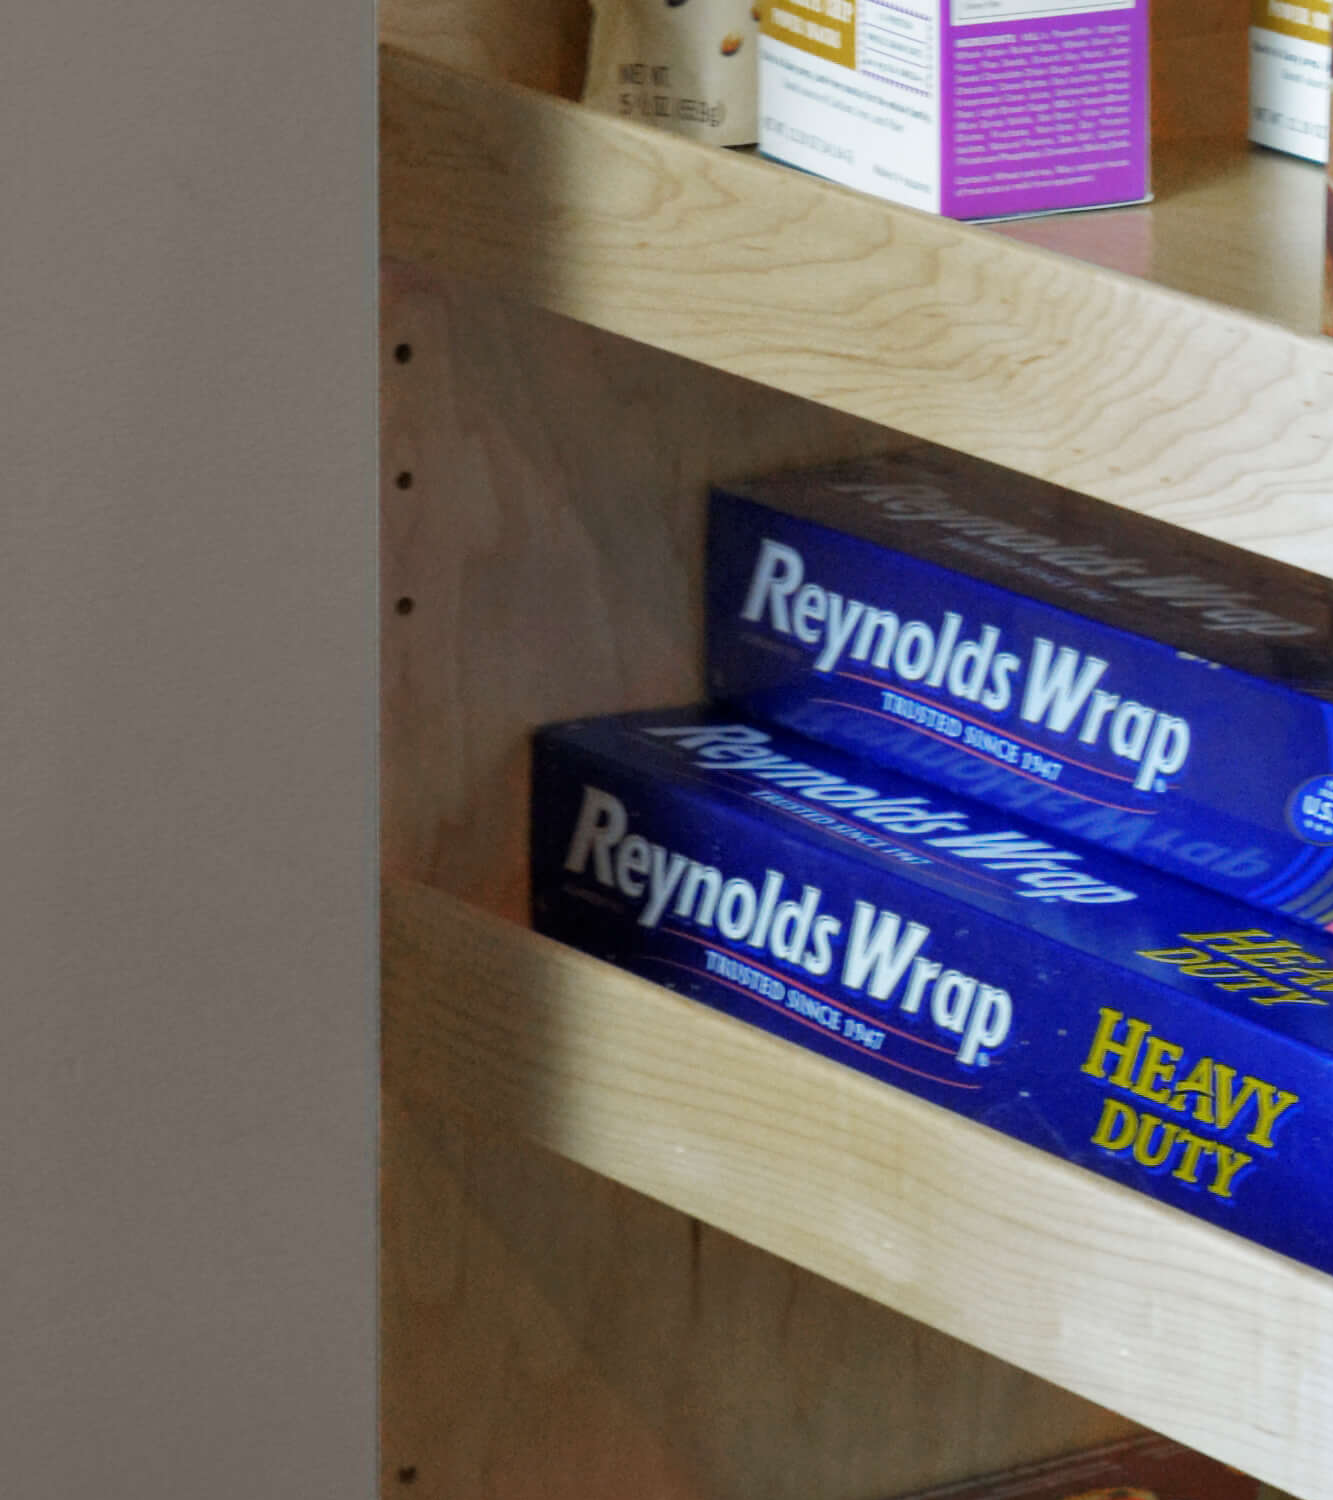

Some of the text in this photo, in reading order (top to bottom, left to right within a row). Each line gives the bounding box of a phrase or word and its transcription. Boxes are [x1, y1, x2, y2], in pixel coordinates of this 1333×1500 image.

[740, 537, 1022, 713] Reynolds
[1020, 636, 1191, 793] Wrap
[880, 690, 963, 738] TRUSTED
[962, 724, 1020, 764] SINCE
[642, 722, 1139, 905] Reynolds Wrap
[564, 784, 1014, 1066] Reynolds Wrap
[1133, 946, 1329, 1007] DUTY
[704, 950, 887, 1051] TRUSTED SINCE 1947
[1080, 1006, 1300, 1150] HEAVY
[1090, 1097, 1253, 1199] DUTY
